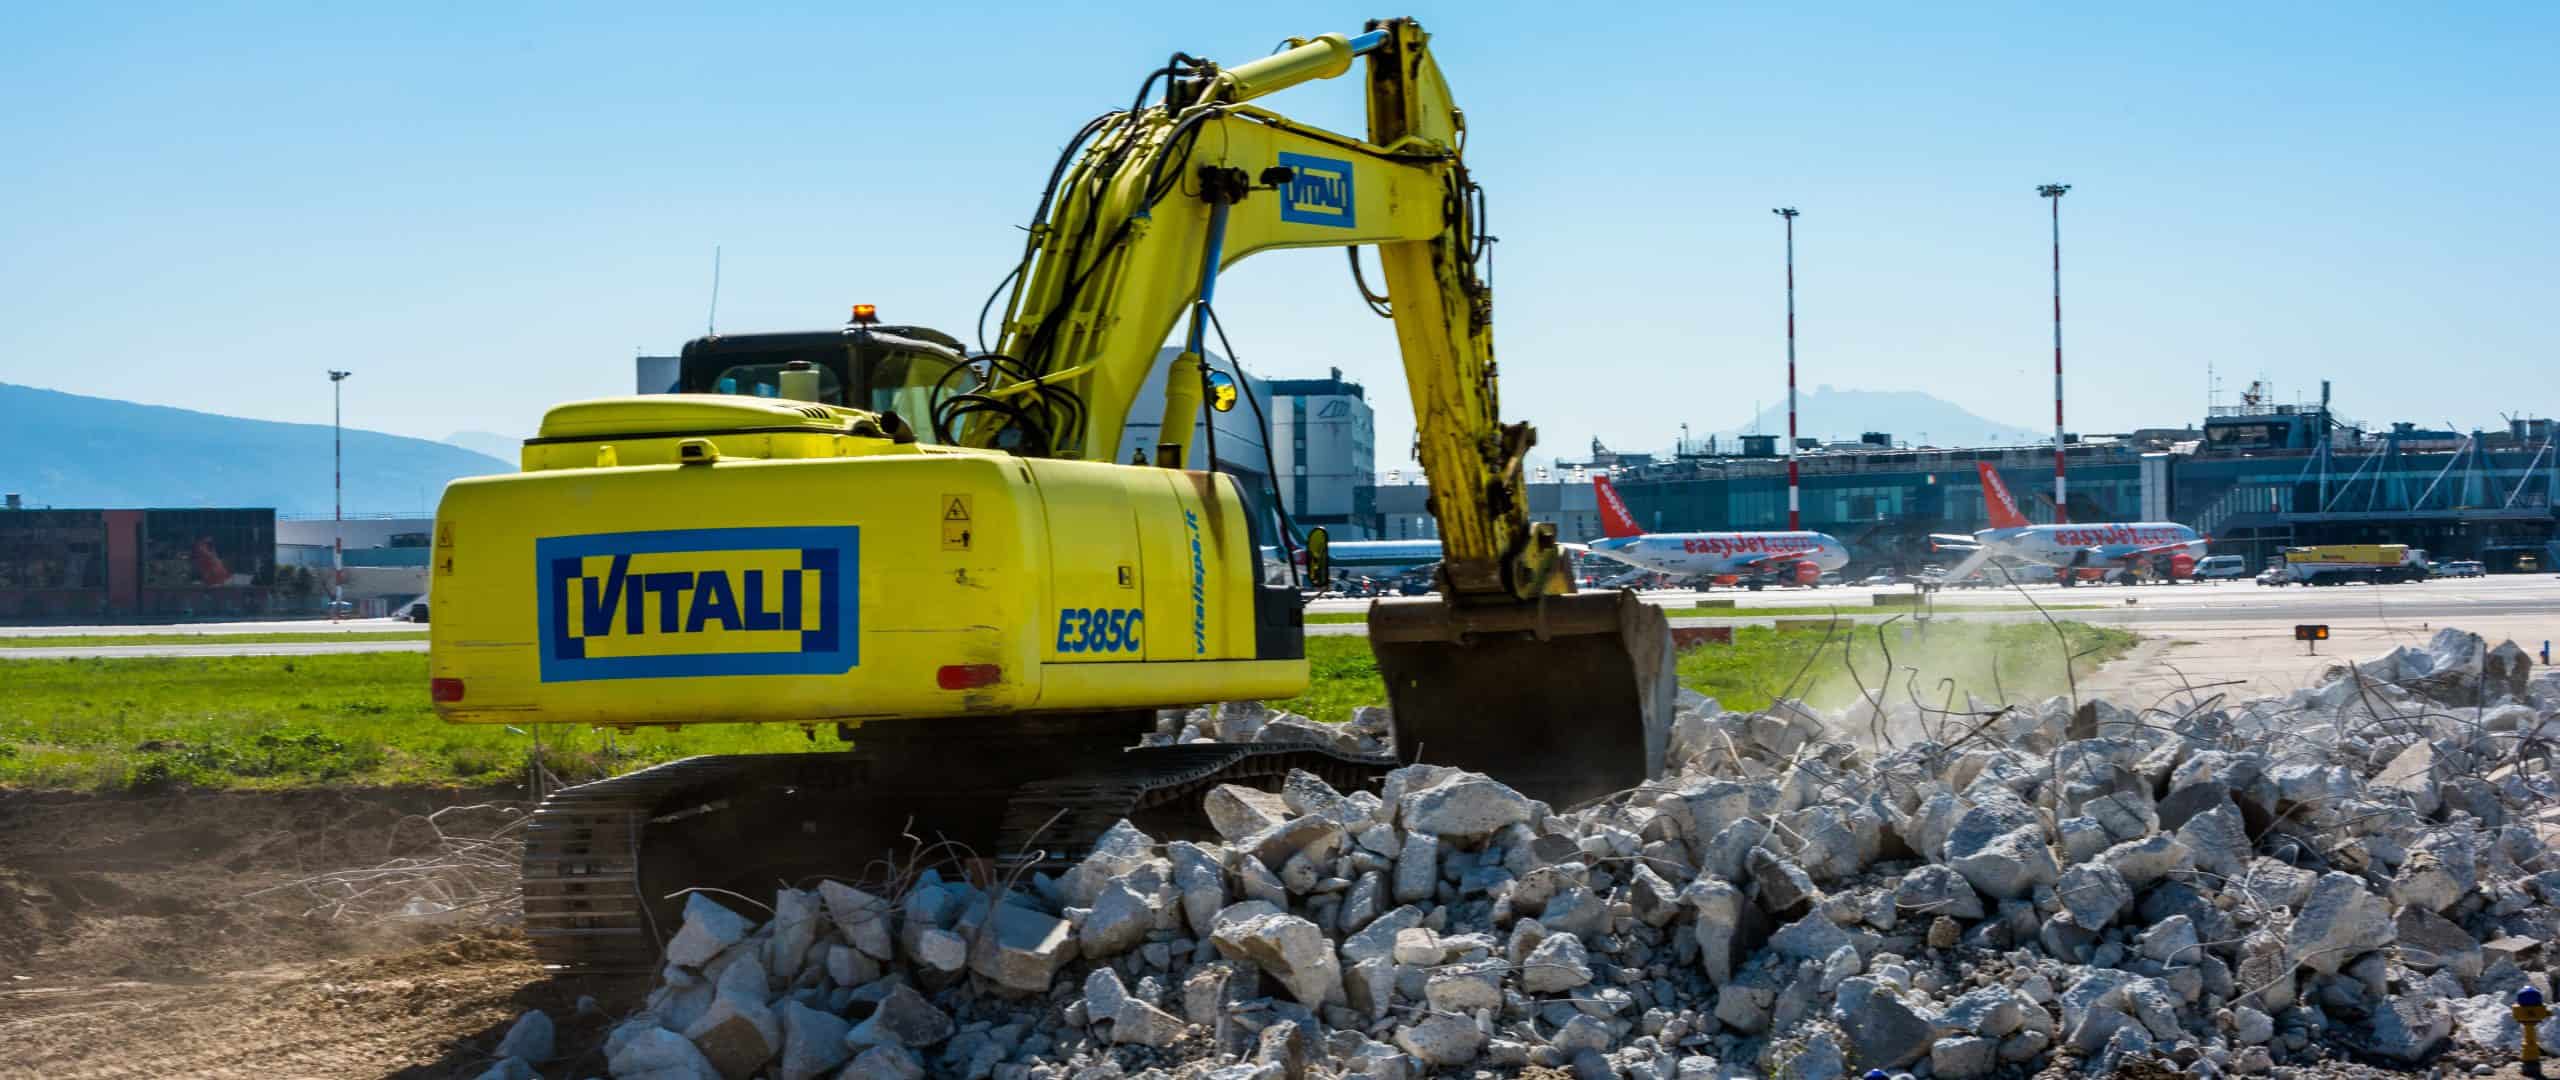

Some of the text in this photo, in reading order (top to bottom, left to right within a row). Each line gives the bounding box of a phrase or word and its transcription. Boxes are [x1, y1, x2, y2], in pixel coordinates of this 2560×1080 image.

[1293, 167, 1342, 208] VITALI
[1683, 535, 1810, 558] easyJet.com
[2055, 525, 2180, 547] easyJet.com
[582, 554, 802, 637] VITALI
[1184, 508, 1205, 655] vitalispa.it
[1056, 607, 1144, 653] E385C
